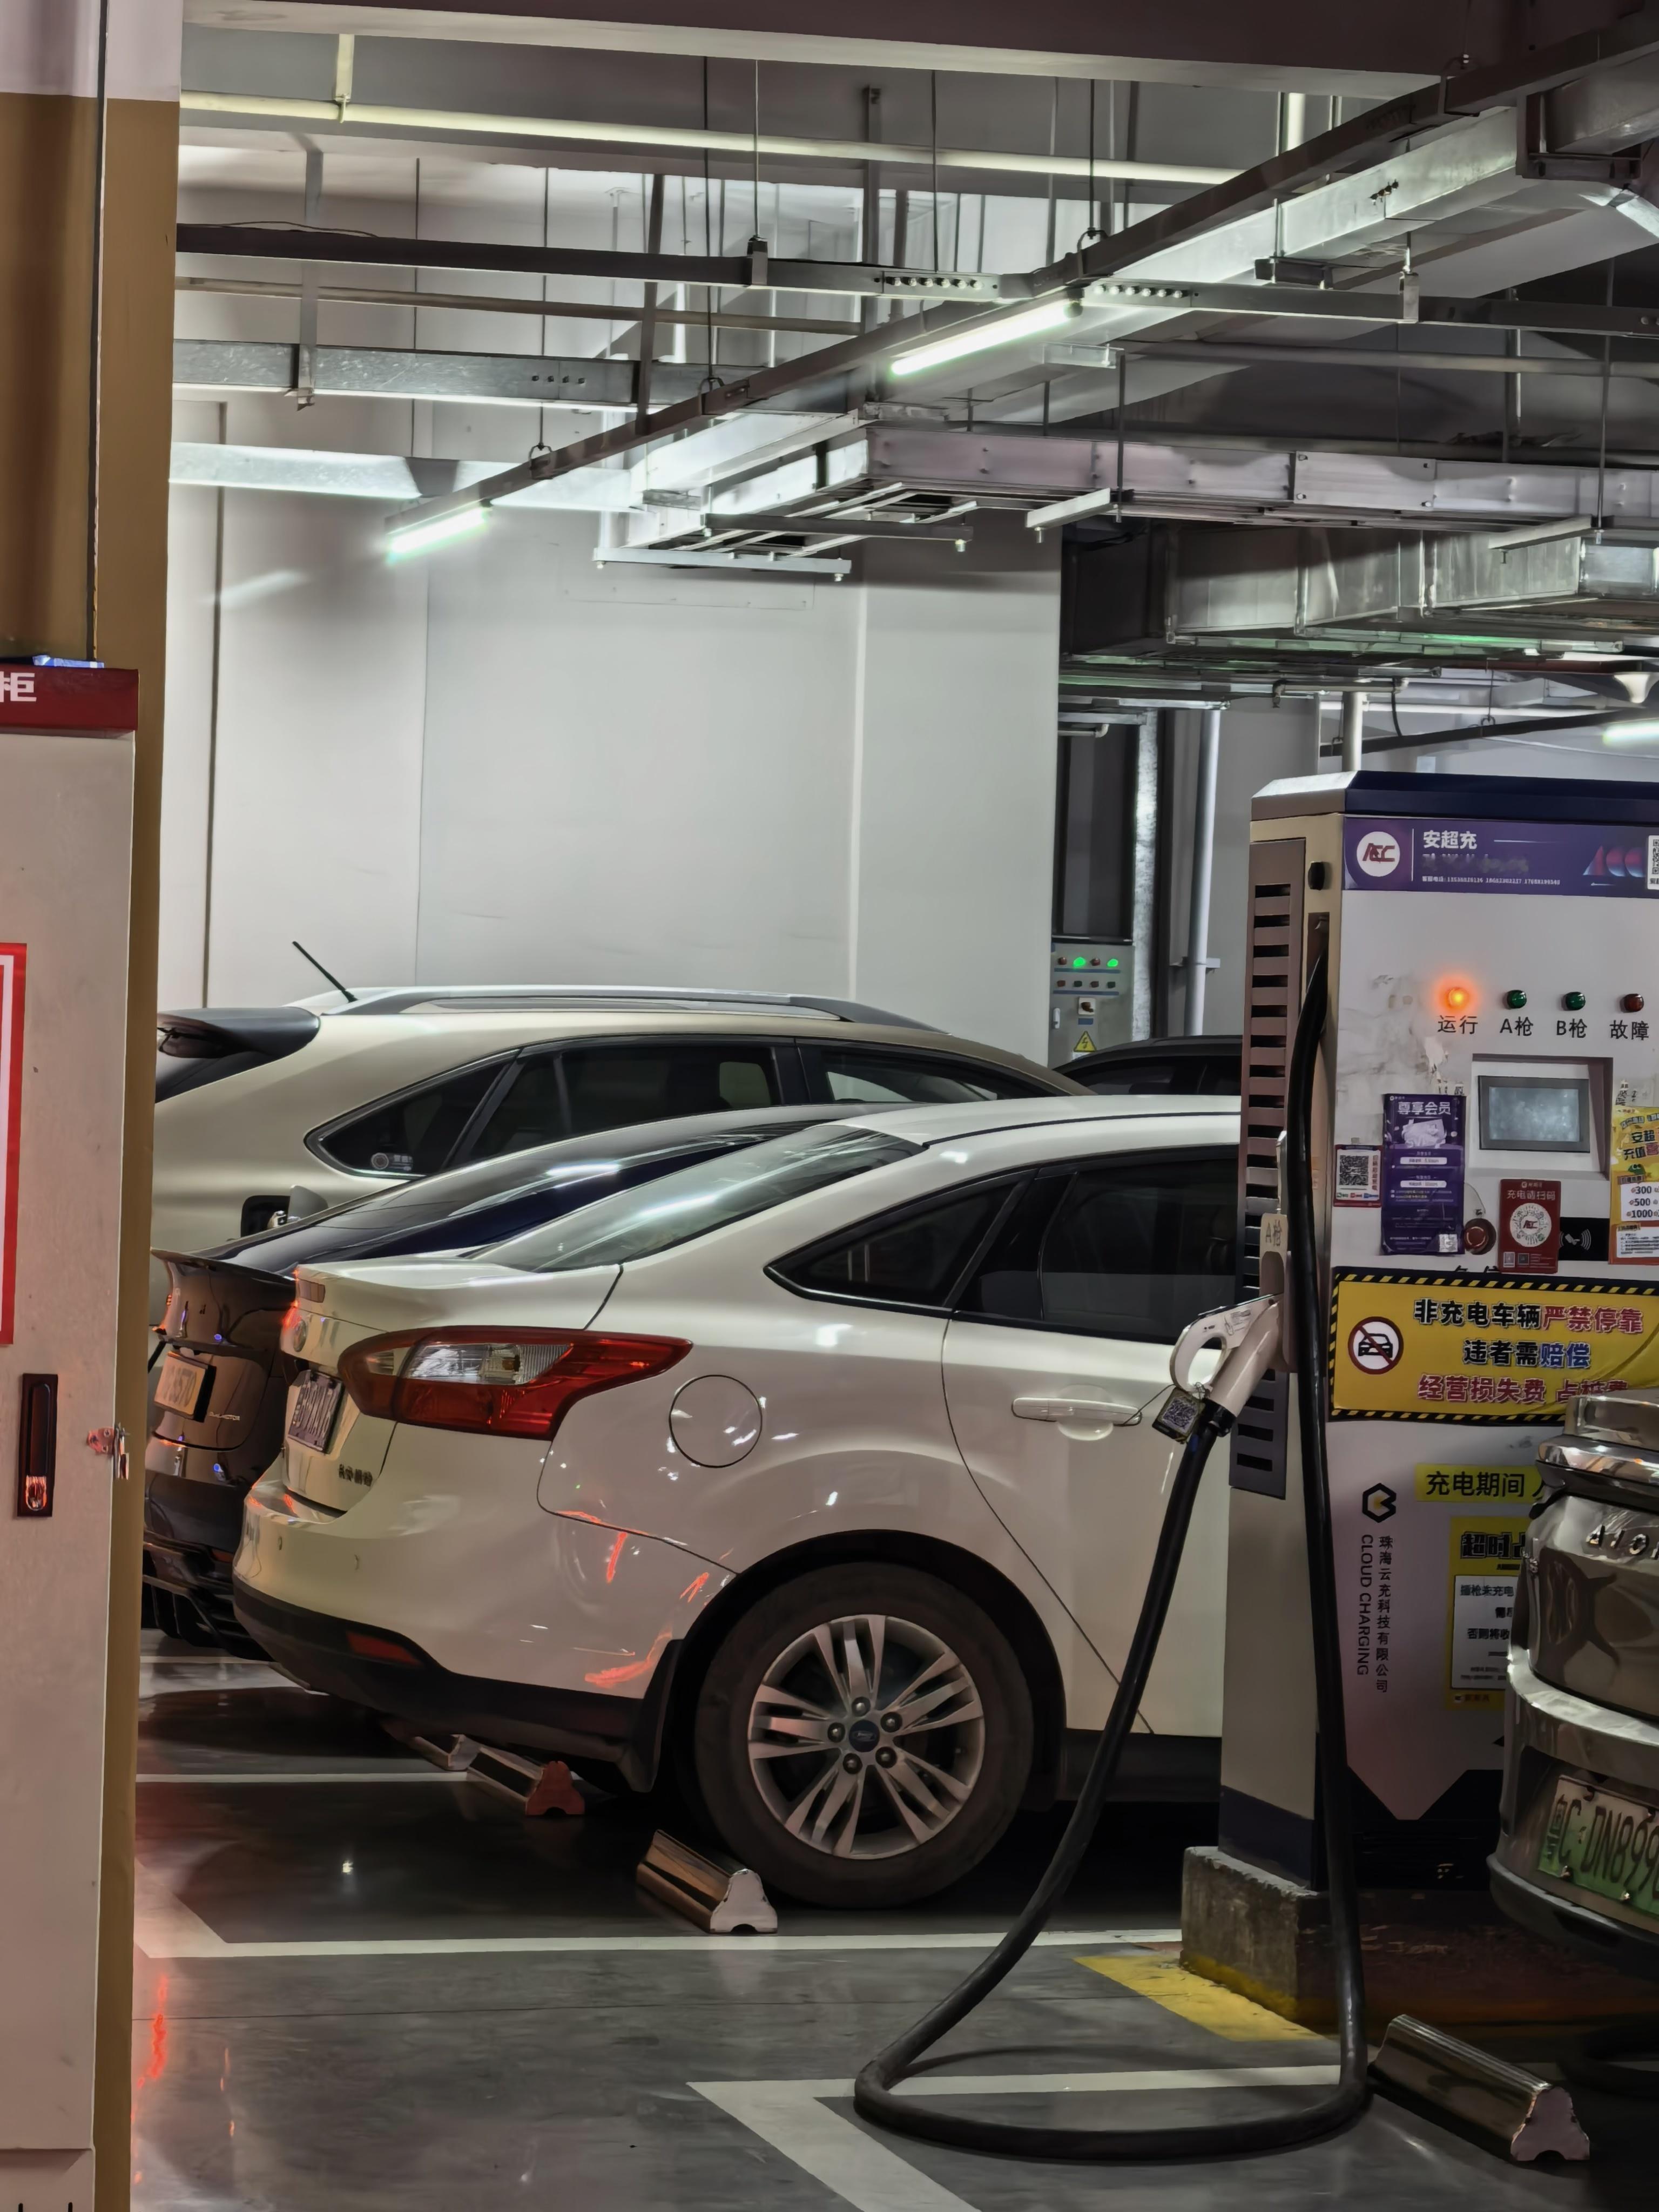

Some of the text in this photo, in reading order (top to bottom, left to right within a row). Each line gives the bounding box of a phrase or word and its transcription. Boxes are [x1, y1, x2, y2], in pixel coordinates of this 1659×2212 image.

[1423, 830, 1478, 849] 安超充
[1438, 1015, 1478, 1035] 运行
[1500, 1016, 1534, 1037] A枪
[1556, 1019, 1587, 1039] B枪
[1610, 1020, 1649, 1041] 故障
[1398, 1102, 1451, 1115] 尊享会员
[1635, 1186, 1652, 1195] 300
[1634, 1198, 1650, 1206] 500
[1631, 1210, 1653, 1218] 1000
[1414, 1299, 1644, 1333] 非充电车辆严禁停靠
[1464, 1339, 1592, 1368] 违者需赔偿
[1418, 1374, 1546, 1404] 经营损失费
[1426, 1471, 1525, 1497] 充电期间
[1357, 1534, 1373, 1675] CLOUD CHARGING
[1375, 1535, 1393, 1693] 珠海云充科技有限公司
